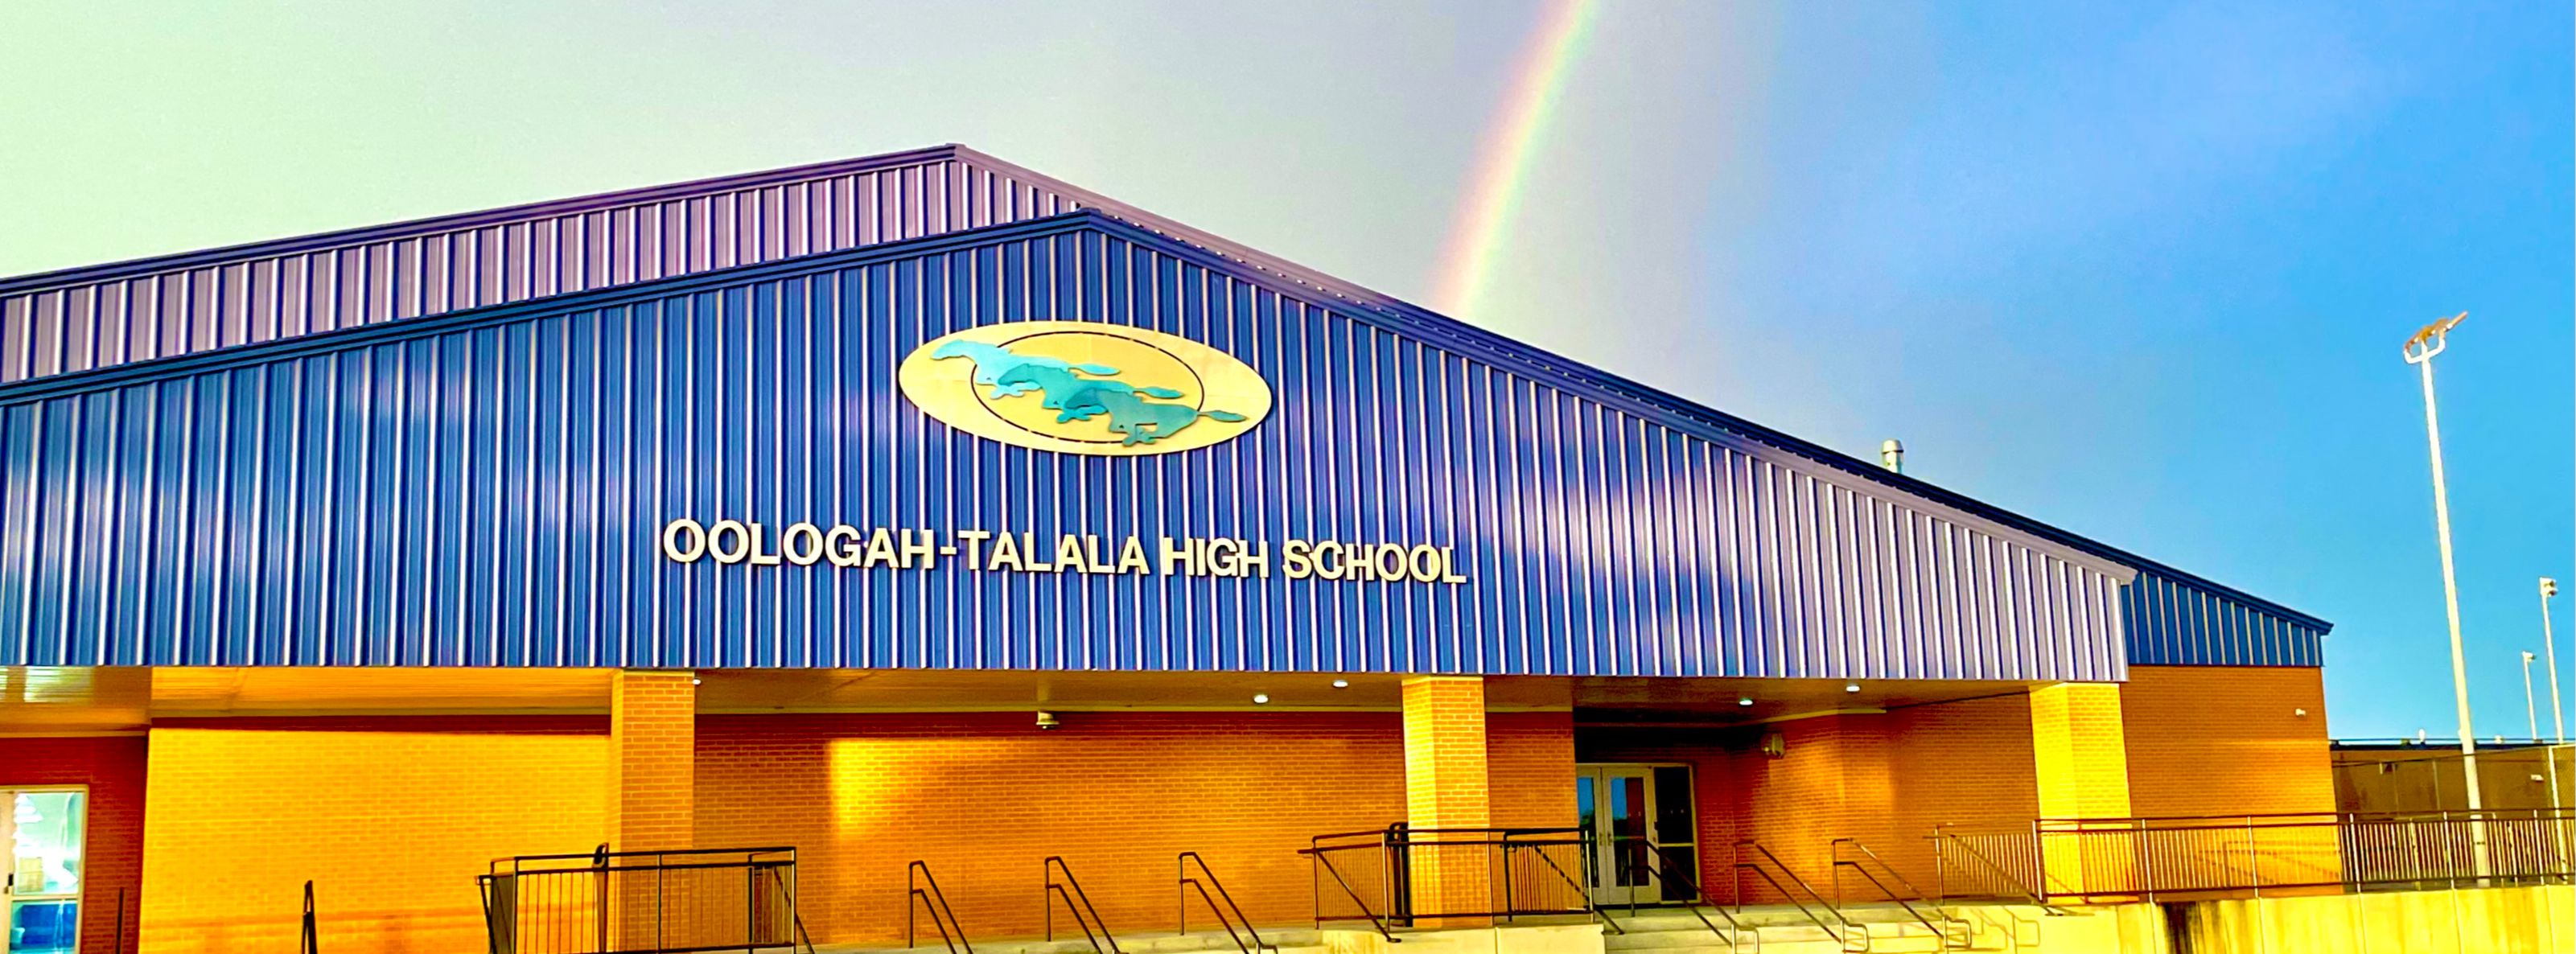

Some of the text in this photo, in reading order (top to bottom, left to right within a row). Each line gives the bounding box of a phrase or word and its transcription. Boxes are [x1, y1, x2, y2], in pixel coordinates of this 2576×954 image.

[663, 518, 1467, 584] OOLOGAH-TALALA HIGH SCHOOL
